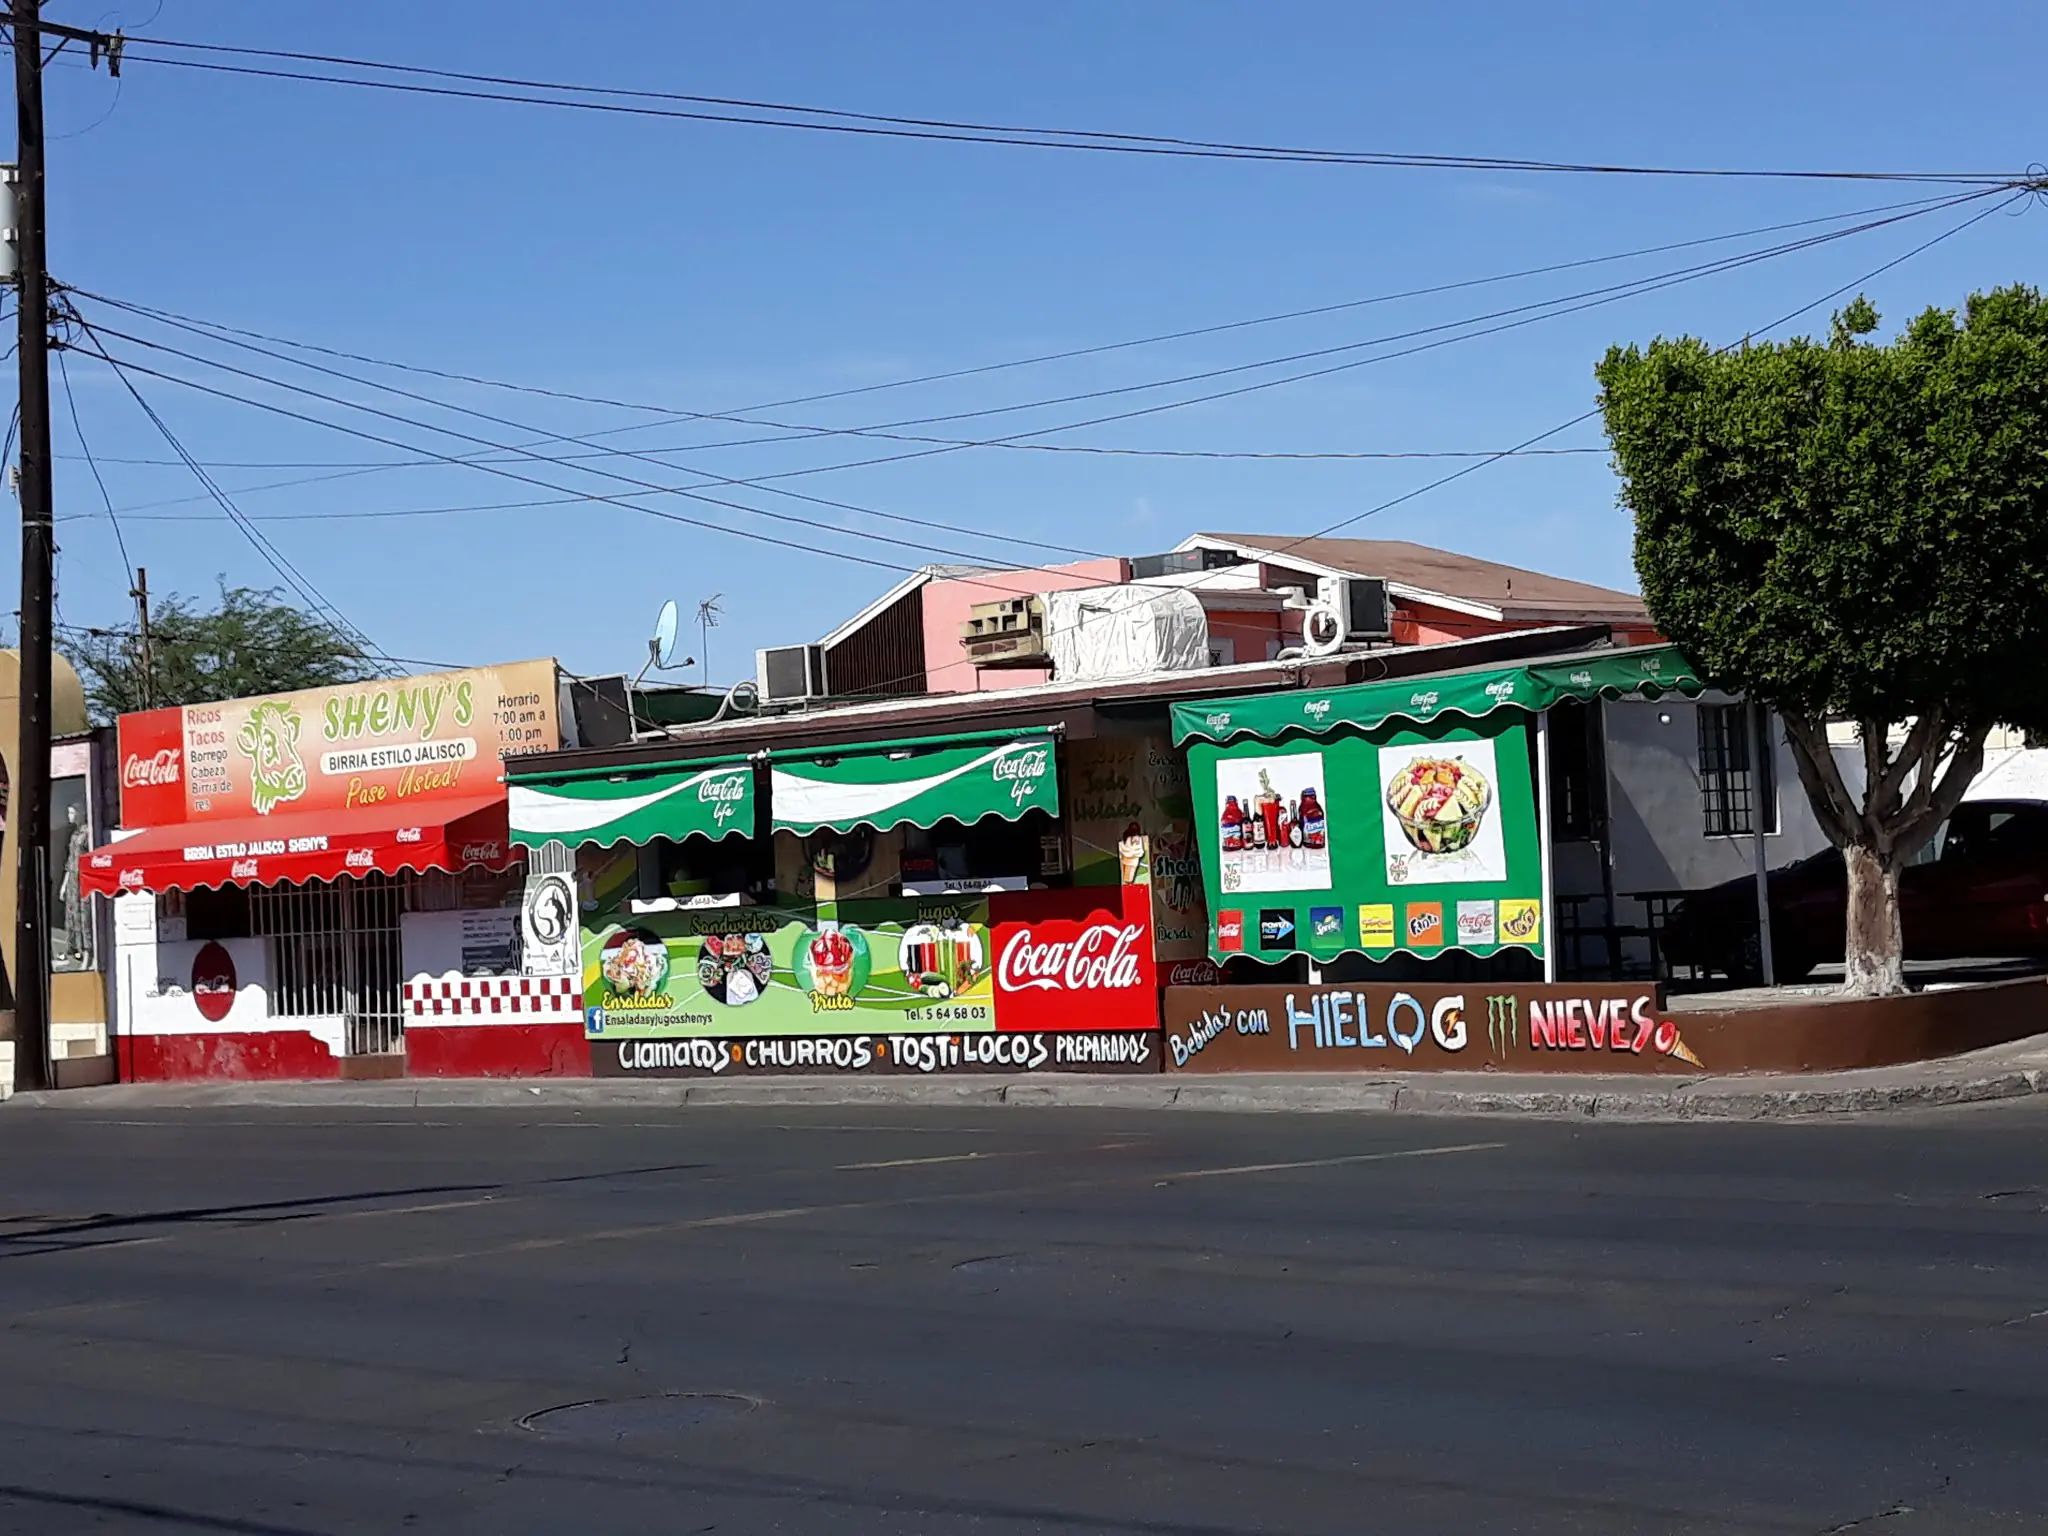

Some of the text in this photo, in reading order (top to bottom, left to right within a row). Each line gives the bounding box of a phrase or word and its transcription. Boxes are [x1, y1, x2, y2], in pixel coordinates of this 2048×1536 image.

[323, 679, 474, 741] SHENY'S
[498, 692, 540, 708] Horario
[187, 709, 222, 725] Ricos
[519, 712, 536, 723] am
[539, 710, 546, 721] a
[188, 730, 225, 747] Tacos
[525, 728, 542, 743] pm
[191, 750, 228, 763] Borrego
[330, 742, 466, 770] BIRRIA ESTILO JALISCO
[993, 750, 1048, 781] Coca-Cola
[123, 749, 181, 788] Coca-Cola
[191, 766, 226, 780] Cabeza
[192, 780, 232, 794] Birria de
[346, 761, 463, 808] Pase Usted!
[698, 776, 747, 803] Coca-Cola
[195, 799, 210, 812] res
[216, 843, 247, 859] ESTILO
[248, 840, 286, 855] JALISCO
[690, 911, 778, 935] Sandwiches
[999, 924, 1146, 992] Coca-Cola
[602, 991, 675, 1010] Ensaladas
[808, 989, 856, 1013] Fruta
[904, 1007, 986, 1020] Tel. 5 64 68 03
[1170, 991, 1426, 1066] Bebidas con HIELO
[1529, 996, 1655, 1053] NIEVES
[618, 1038, 731, 1073] Clamatos
[745, 1036, 872, 1069] CHURROS
[1056, 1032, 1150, 1064] PREPARADOS
